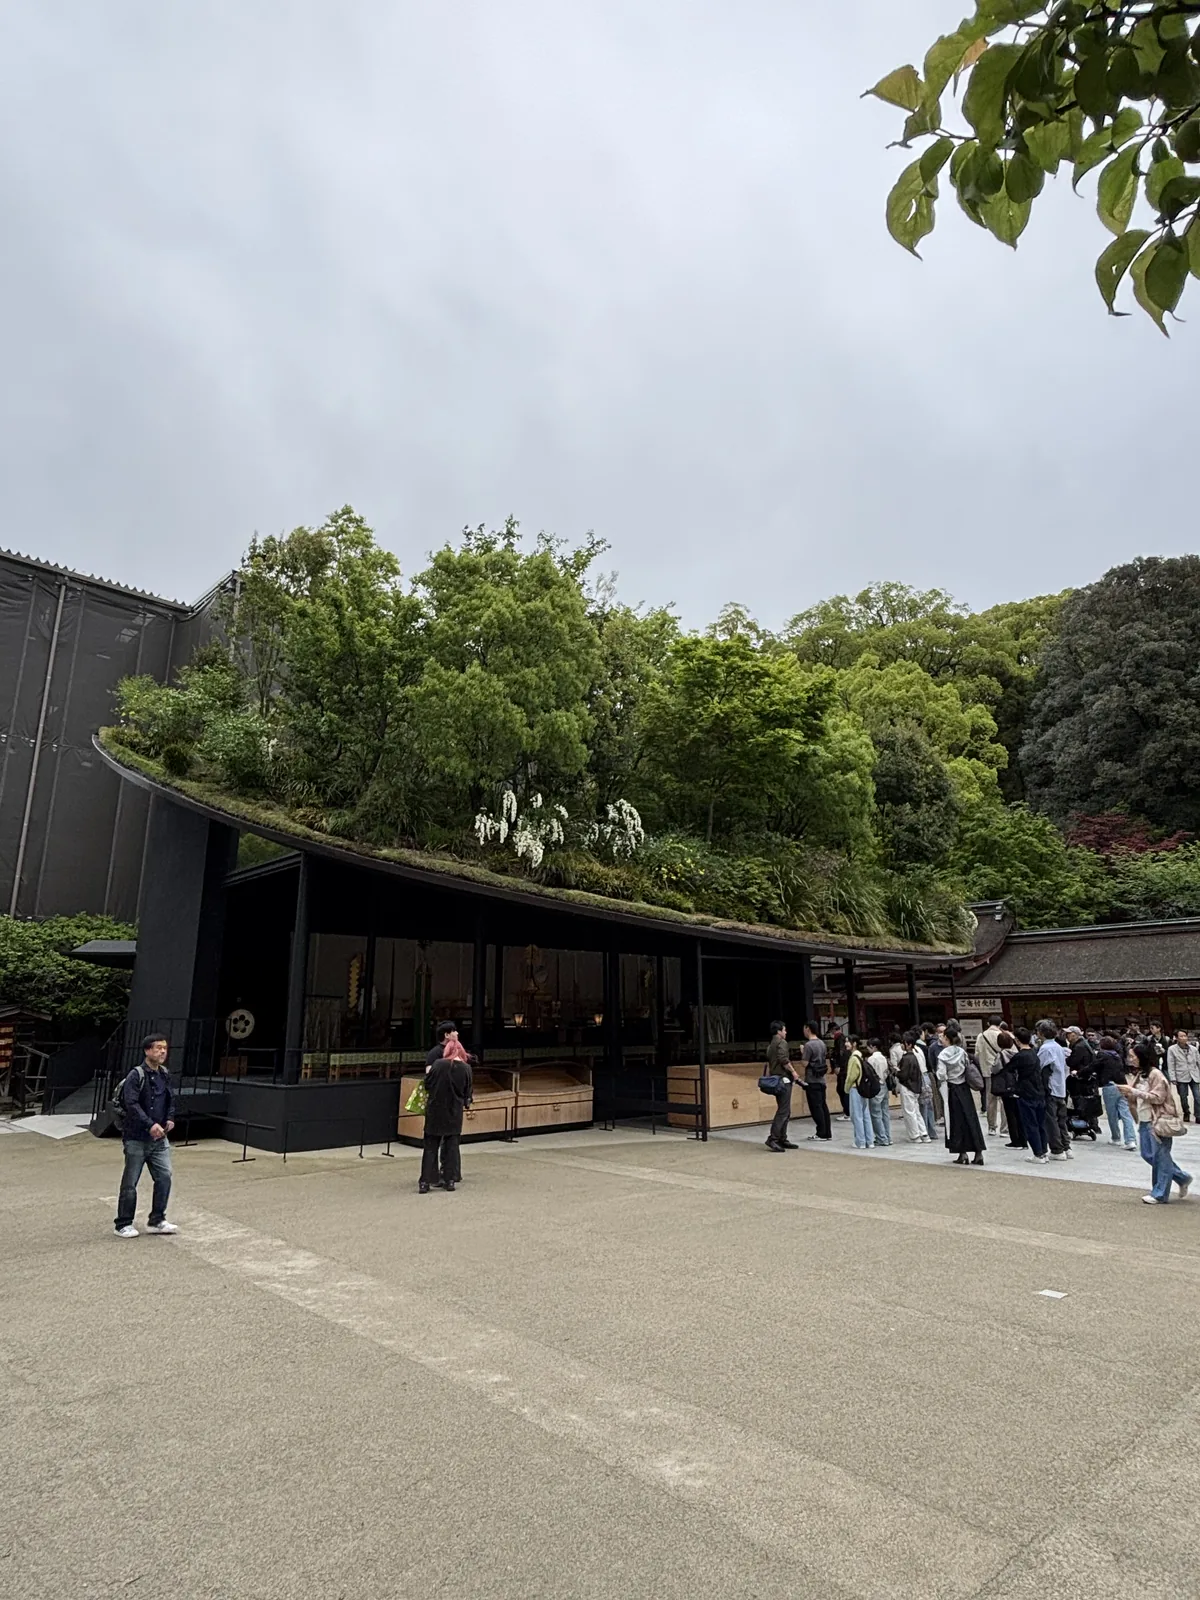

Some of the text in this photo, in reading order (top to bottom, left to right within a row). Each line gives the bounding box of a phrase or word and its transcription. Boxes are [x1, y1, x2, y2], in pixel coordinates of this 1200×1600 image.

[960, 999, 996, 1007] ご寄付受付
